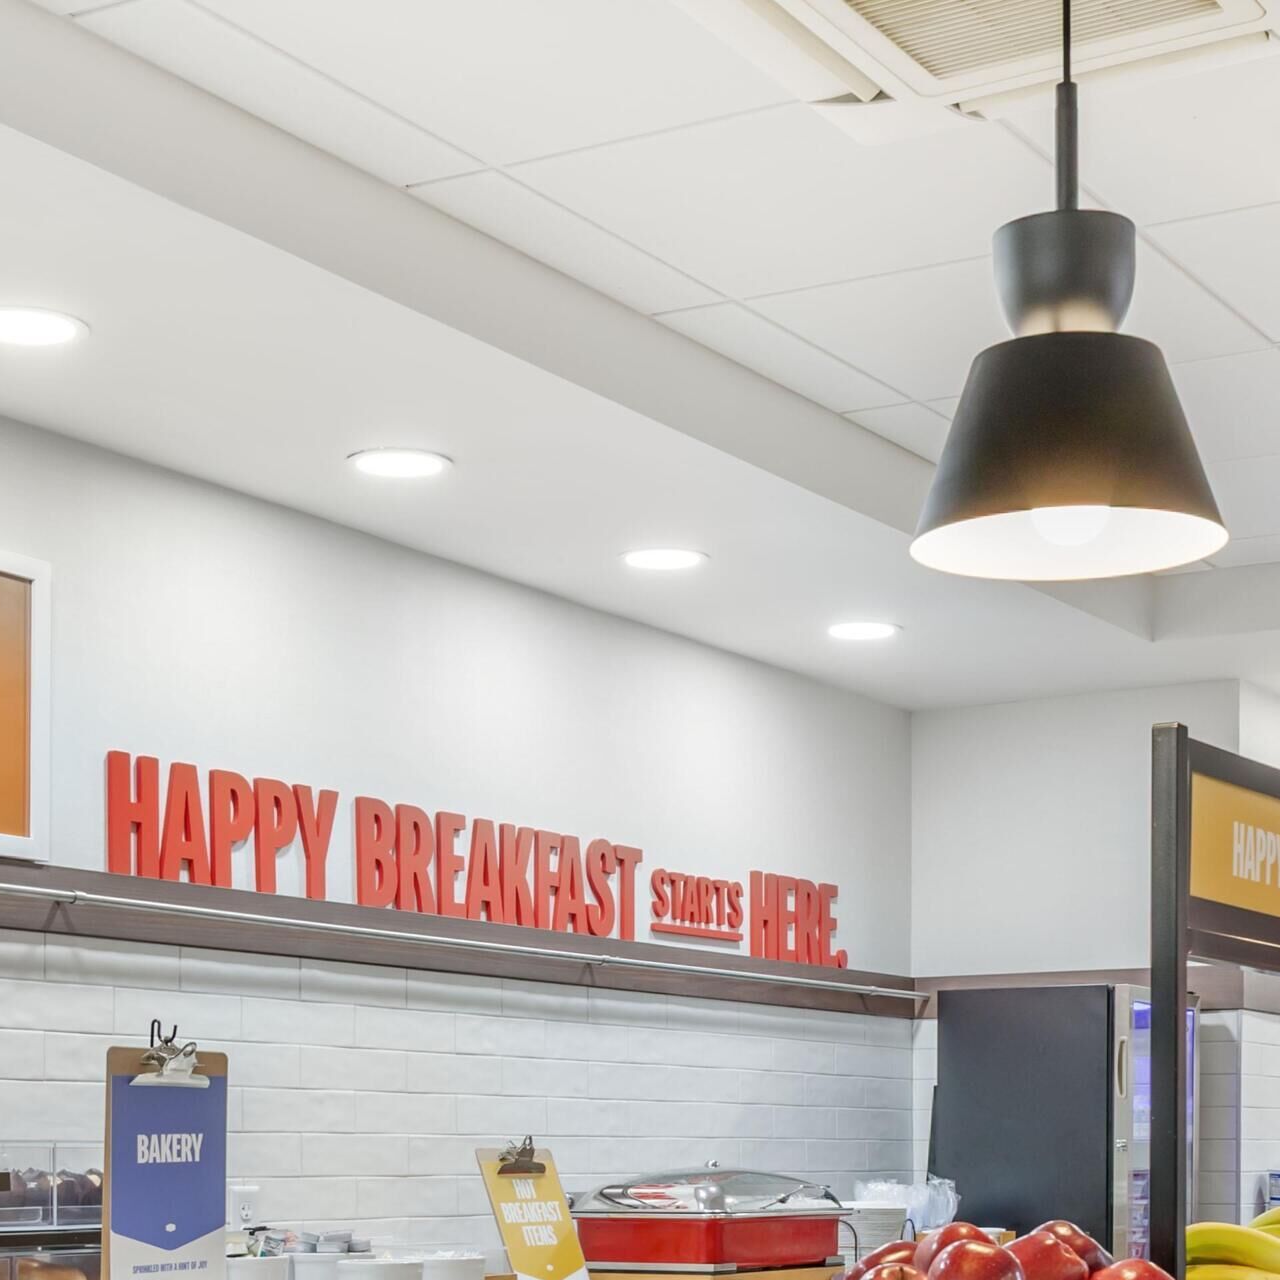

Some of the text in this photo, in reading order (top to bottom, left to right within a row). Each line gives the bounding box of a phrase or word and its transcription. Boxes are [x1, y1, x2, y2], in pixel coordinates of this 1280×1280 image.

[106, 750, 848, 969] HAPPY BREAKFAST STARTS HERE.
[136, 1133, 204, 1164] BAKERY
[511, 1178, 537, 1200] HOT
[499, 1201, 563, 1224] BREAKFAST
[521, 1225, 559, 1246] ITEMS
